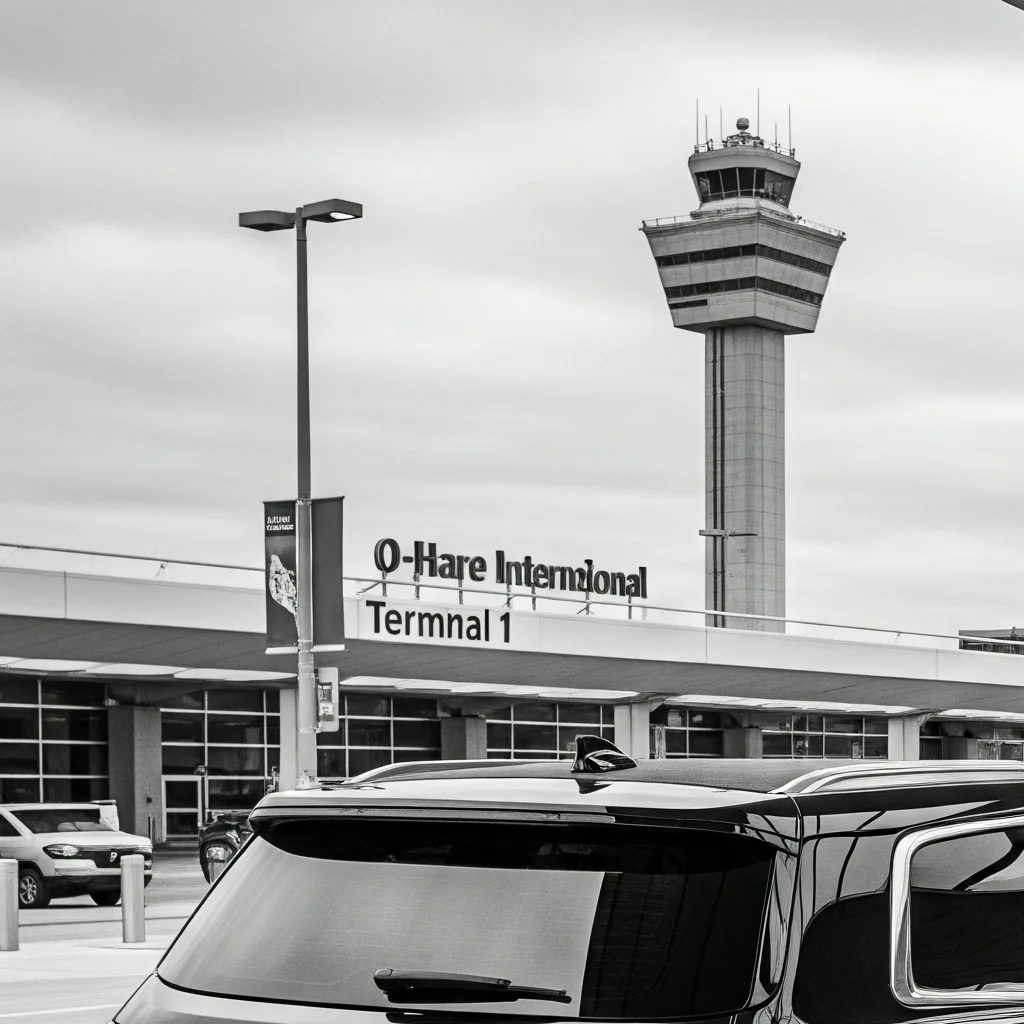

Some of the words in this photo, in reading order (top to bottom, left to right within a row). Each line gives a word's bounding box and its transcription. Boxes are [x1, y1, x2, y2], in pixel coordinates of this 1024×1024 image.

[374, 538, 487, 582] O-Hare
[366, 600, 490, 642] Termnal
[499, 611, 510, 643] 1
